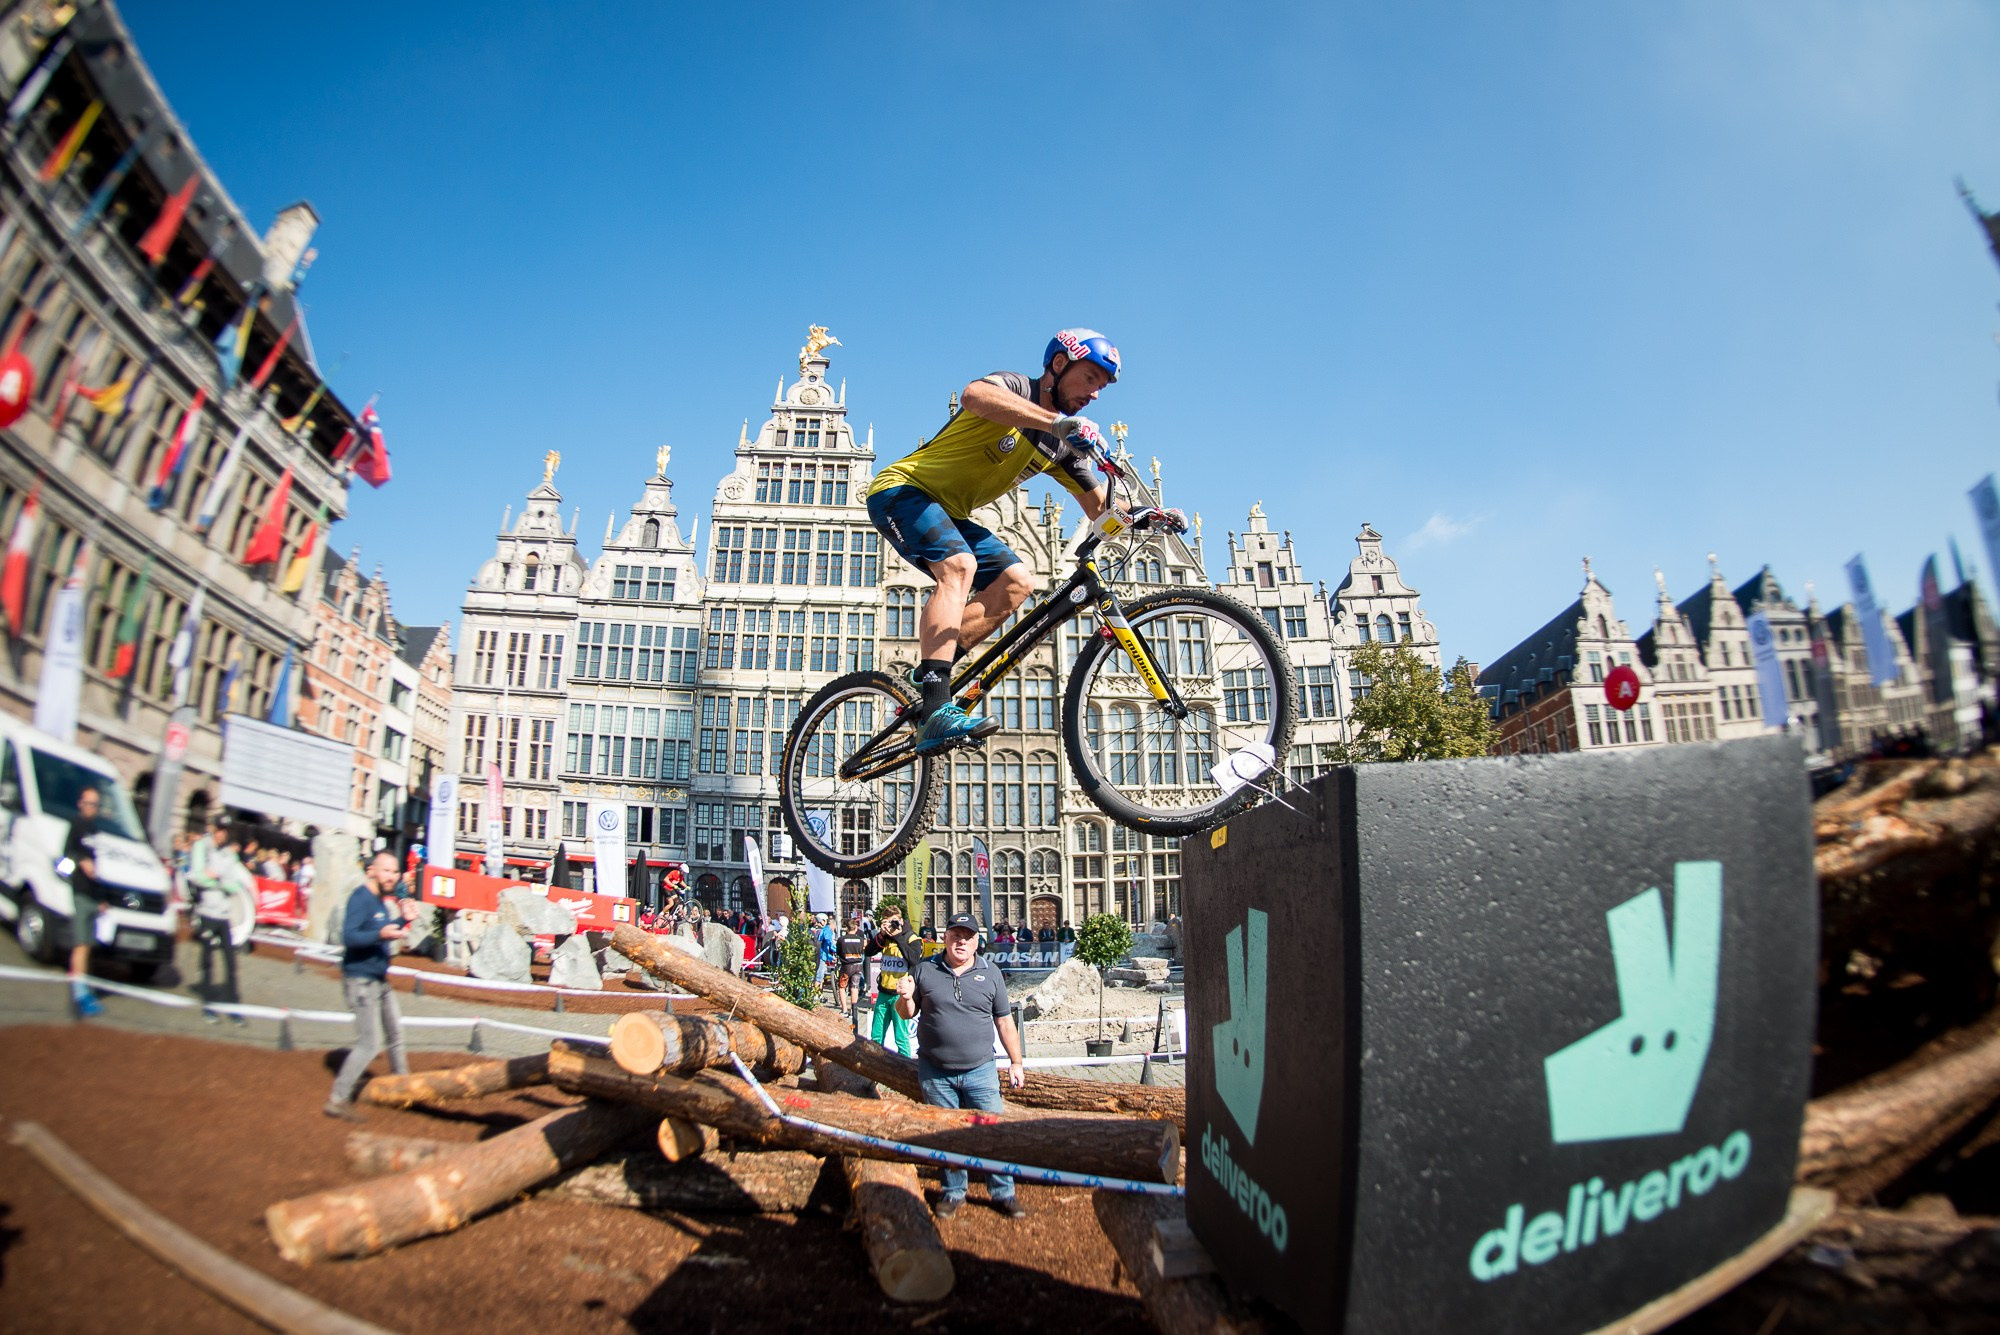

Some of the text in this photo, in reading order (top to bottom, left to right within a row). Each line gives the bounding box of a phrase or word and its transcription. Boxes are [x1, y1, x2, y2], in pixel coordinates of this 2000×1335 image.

[1064, 335, 1089, 360] Bull
[1125, 639, 1157, 686] mybike
[982, 951, 1059, 963] DOOSAN
[1202, 1121, 1288, 1251] deliveroo
[1469, 1130, 1752, 1282] deliveroo
